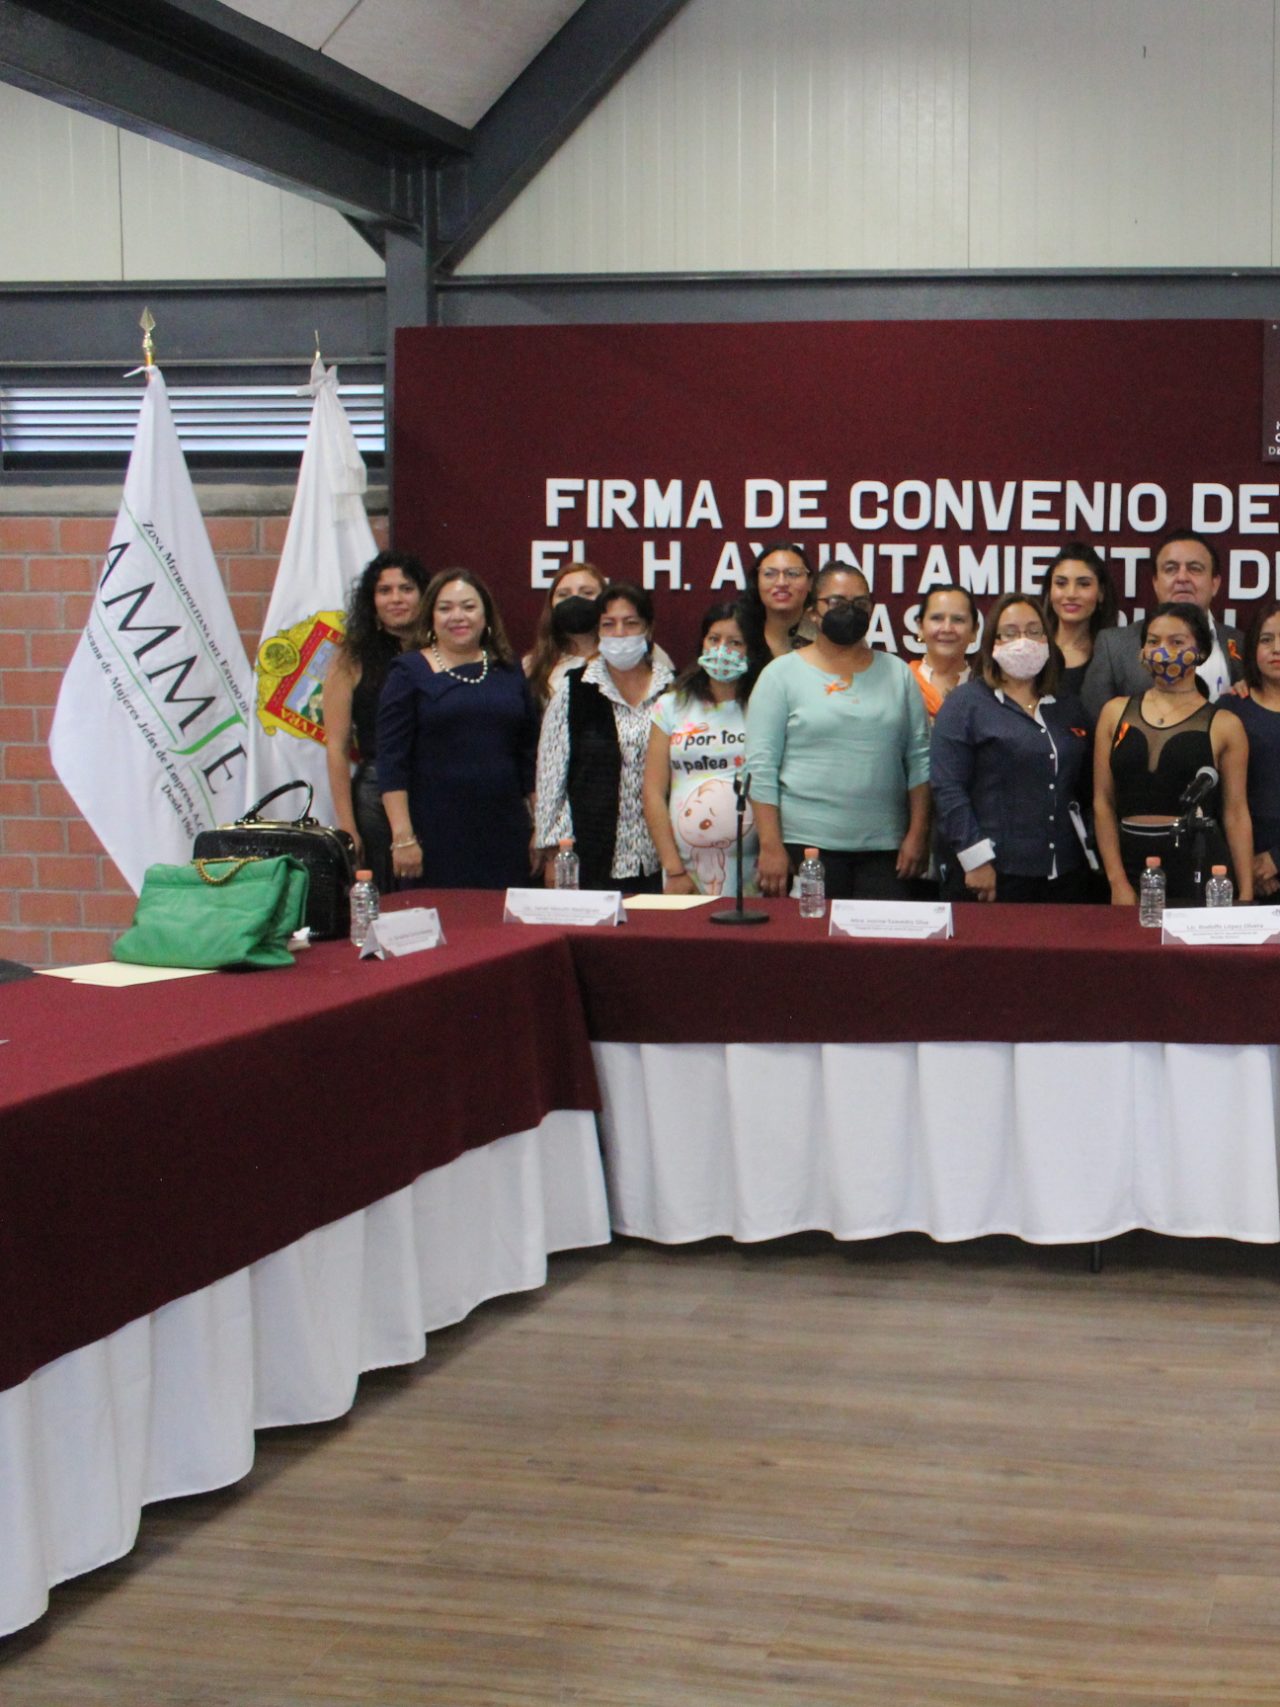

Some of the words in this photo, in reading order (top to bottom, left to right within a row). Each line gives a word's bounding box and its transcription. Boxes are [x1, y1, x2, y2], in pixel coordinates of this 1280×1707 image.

[545, 477, 723, 529] FIRMA
[744, 478, 827, 530] DE
[849, 477, 1167, 534] CONVENIO
[1191, 482, 1280, 535] DE
[642, 540, 692, 591] H.
[109, 677, 140, 722] Mujeres
[137, 719, 159, 750] Jefas
[156, 749, 168, 765] de
[683, 733, 717, 751] por
[683, 755, 728, 775] patea
[161, 783, 184, 816] Desde
